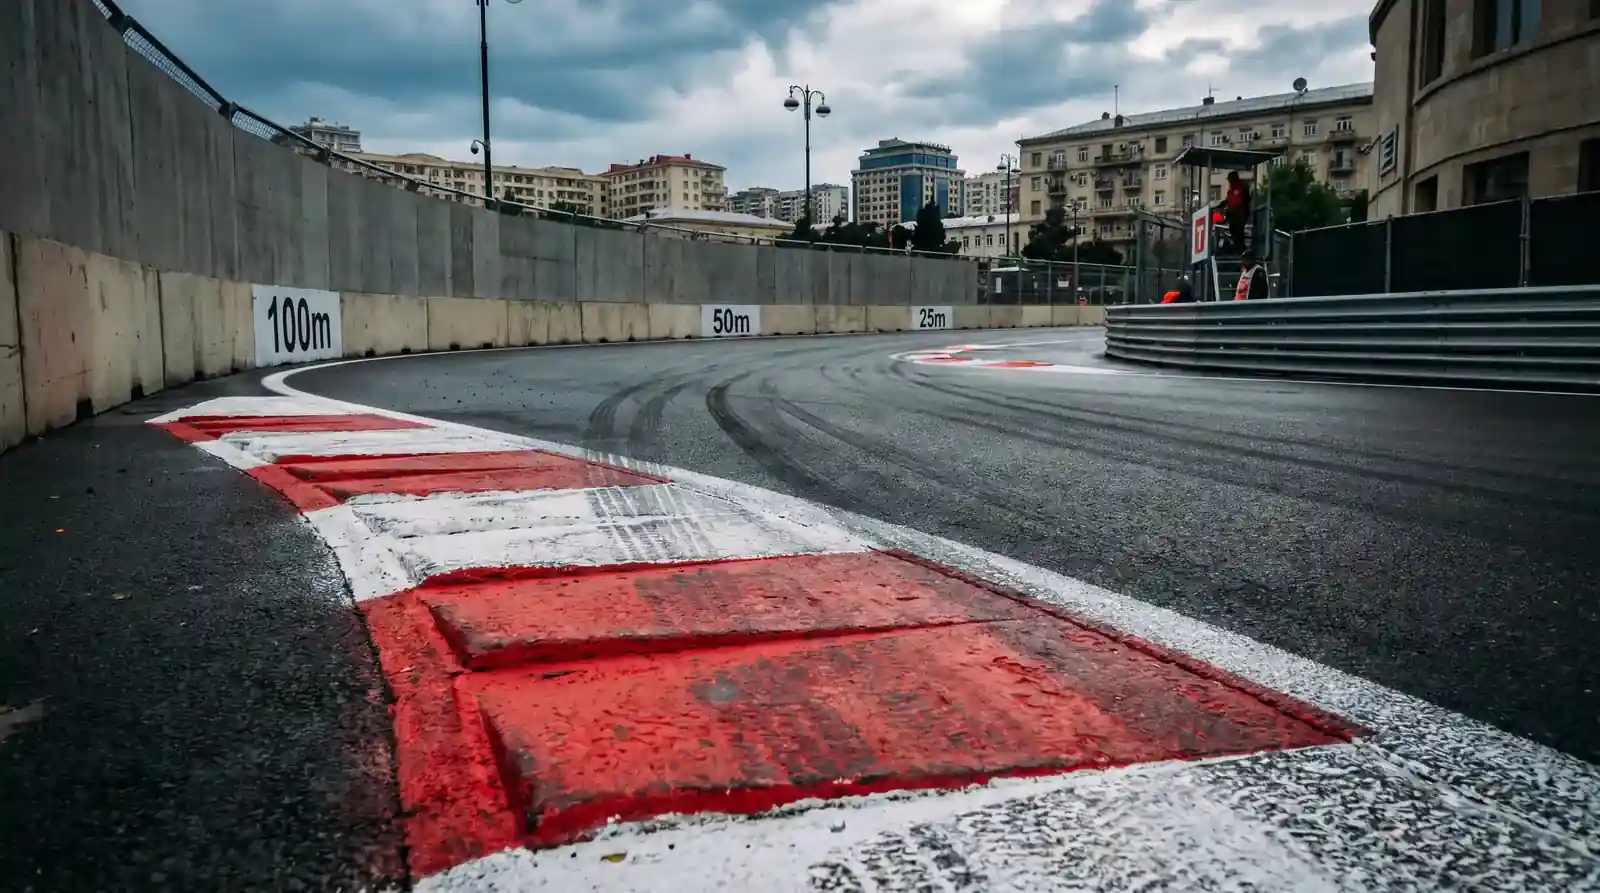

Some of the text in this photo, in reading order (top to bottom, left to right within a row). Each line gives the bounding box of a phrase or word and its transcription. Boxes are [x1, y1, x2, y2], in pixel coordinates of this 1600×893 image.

[268, 295, 331, 353] 100m
[713, 308, 750, 333] 50m
[919, 308, 946, 328] 25m
